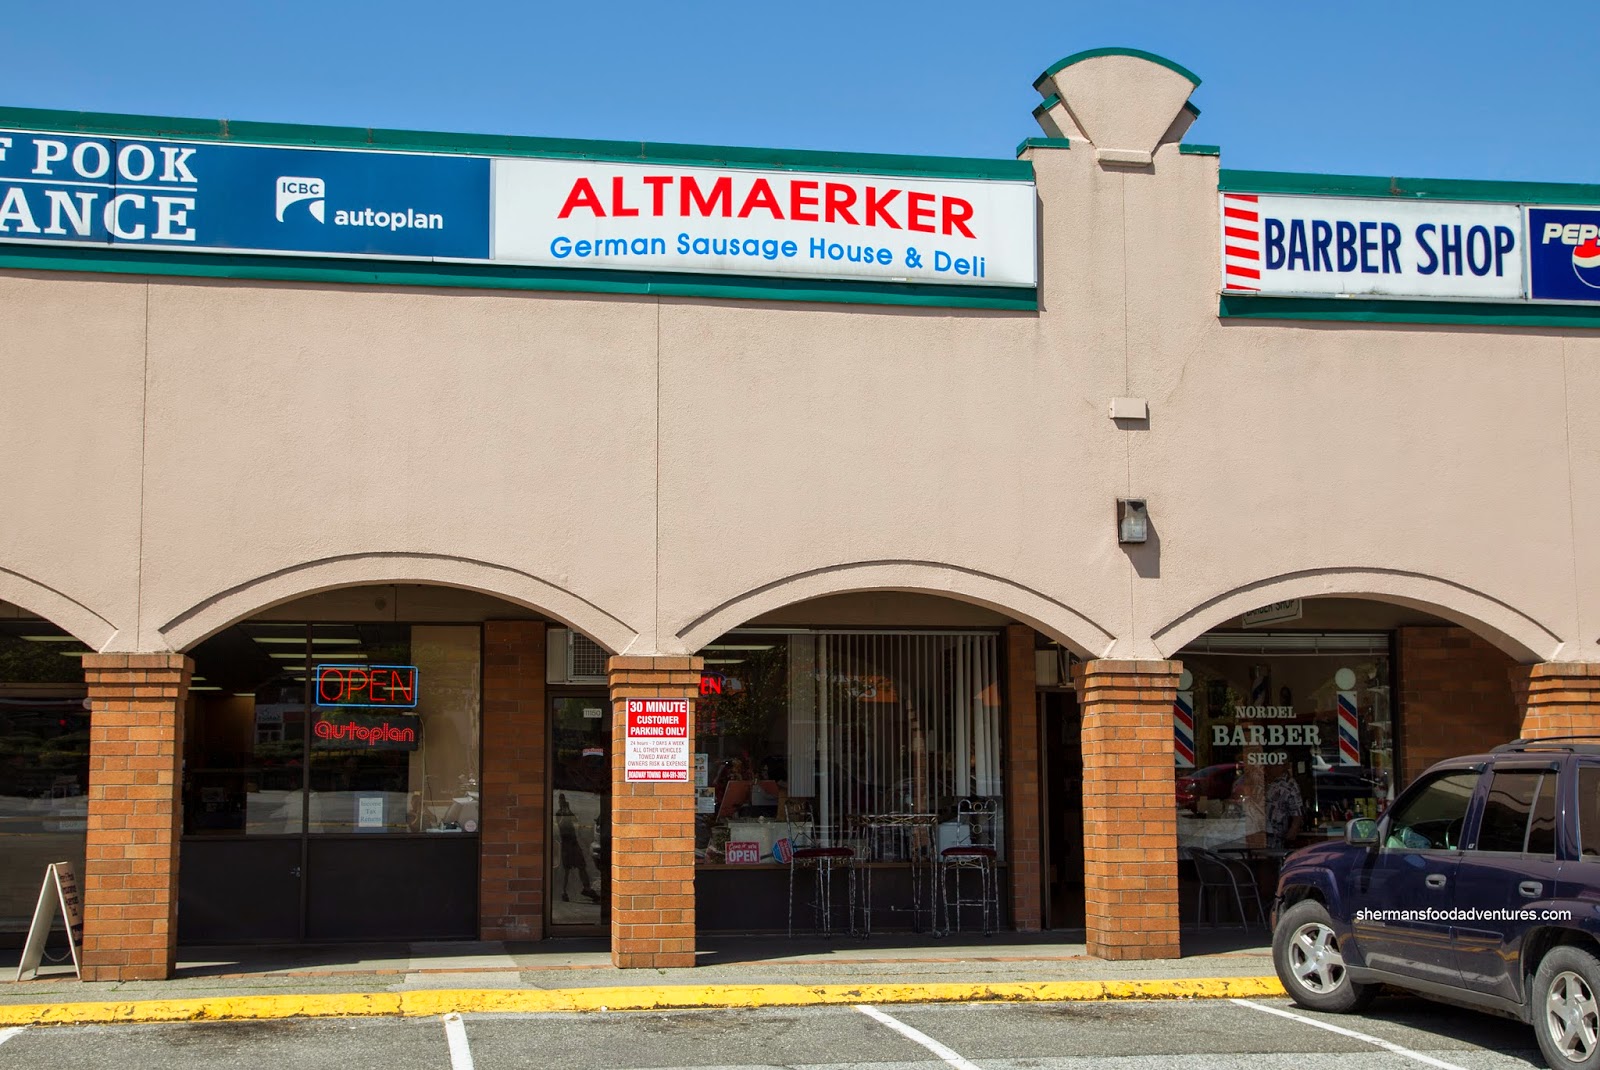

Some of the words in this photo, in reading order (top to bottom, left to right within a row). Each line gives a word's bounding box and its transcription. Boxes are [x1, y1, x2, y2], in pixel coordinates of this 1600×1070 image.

[32, 139, 198, 183] POOK
[282, 182, 320, 195] ICBC
[0, 187, 196, 241] ANCE
[334, 208, 443, 231] autoplan
[557, 176, 977, 240] ALTMAERKER
[1542, 223, 1600, 246] PEP
[550, 236, 666, 259] German
[676, 232, 798, 261] Sausage
[809, 237, 893, 266] House
[905, 247, 923, 269] &
[934, 250, 986, 278] Deli
[1264, 218, 1402, 274] BARBER
[1415, 223, 1515, 277] SHOP
[320, 669, 413, 701] OPEN
[630, 702, 643, 712] 30
[646, 701, 686, 712] MINUTE
[1235, 705, 1297, 719] NORDEL
[630, 727, 664, 735] PARKING
[666, 727, 685, 735] ONLY
[637, 716, 679, 724] CUSTOMER
[314, 720, 415, 745] autoplan
[1212, 725, 1322, 746] BARBER
[1247, 752, 1288, 766] SHOP
[729, 850, 757, 862] OPEN
